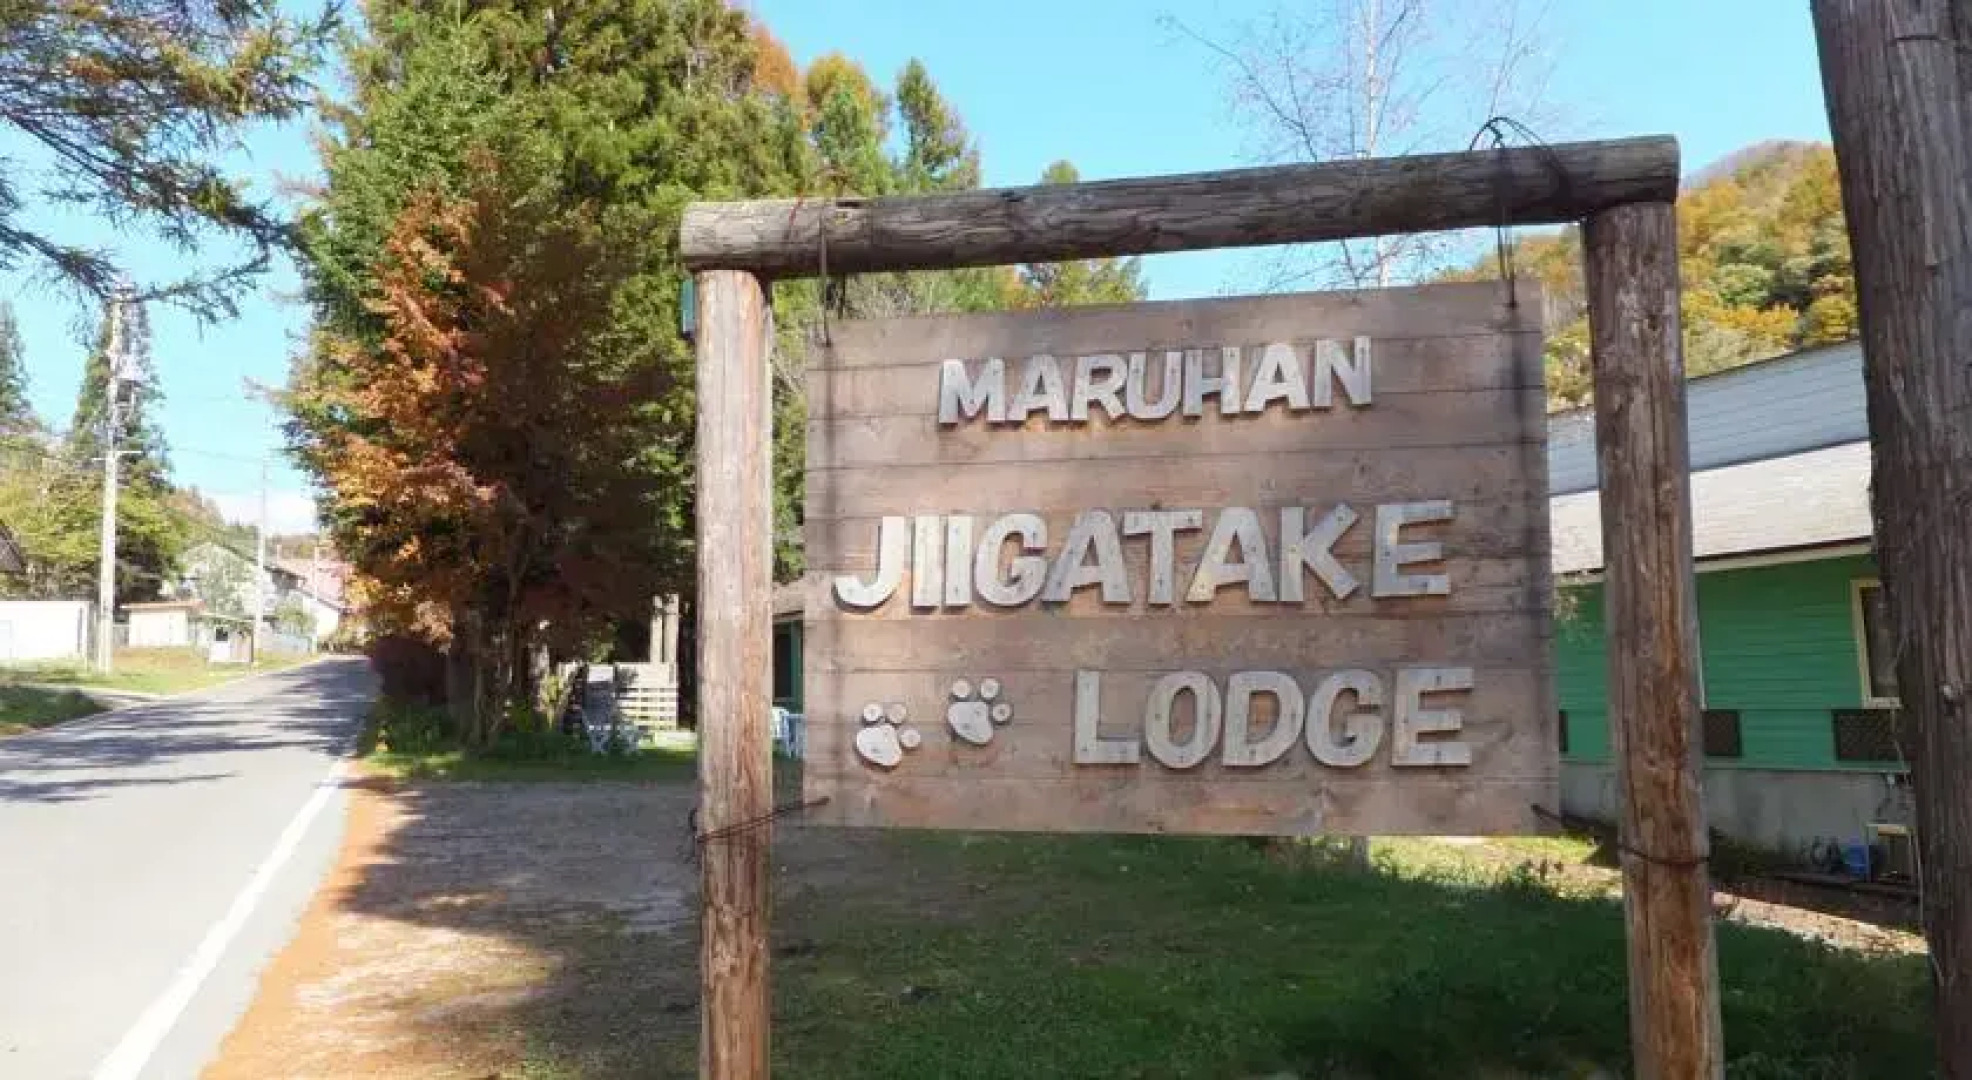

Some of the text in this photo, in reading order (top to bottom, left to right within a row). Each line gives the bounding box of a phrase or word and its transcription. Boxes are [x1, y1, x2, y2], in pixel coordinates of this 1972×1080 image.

[938, 337, 1372, 425] MARUHAN
[833, 500, 1455, 612] JIIGATAKE
[1073, 667, 1474, 769] LODGE
